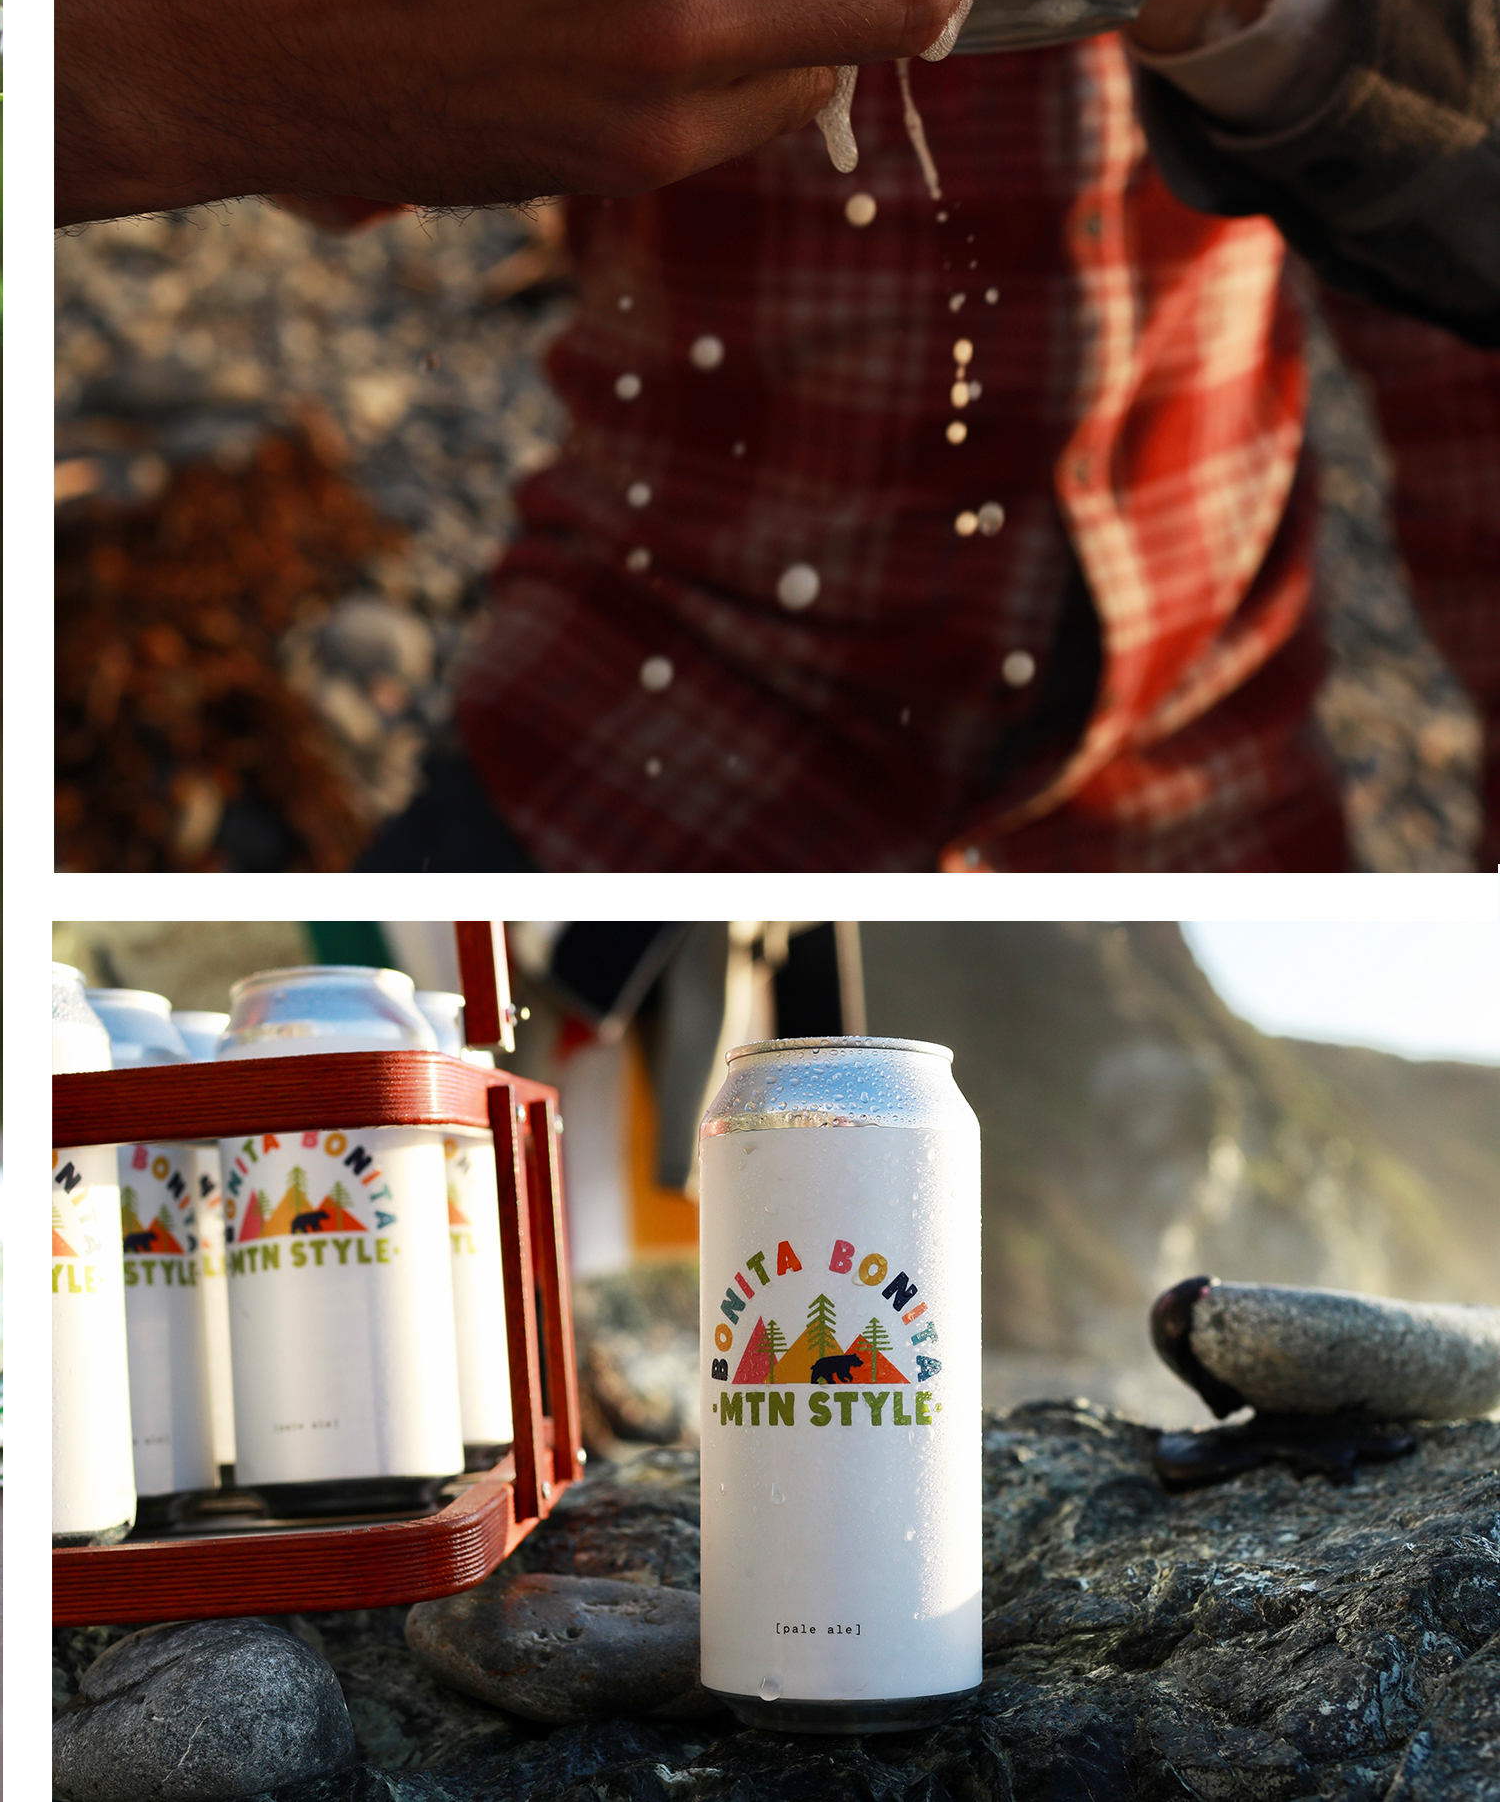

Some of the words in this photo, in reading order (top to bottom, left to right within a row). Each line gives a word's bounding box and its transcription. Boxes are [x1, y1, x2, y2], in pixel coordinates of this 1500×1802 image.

[52, 1151, 102, 1257] NITA
[290, 1237, 391, 1268] STYLE
[52, 1263, 98, 1294] YLE
[711, 1240, 803, 1382] BONITA
[828, 1239, 943, 1383] BONITA
[720, 1391, 795, 1427] MTN
[808, 1390, 933, 1427] STYLE
